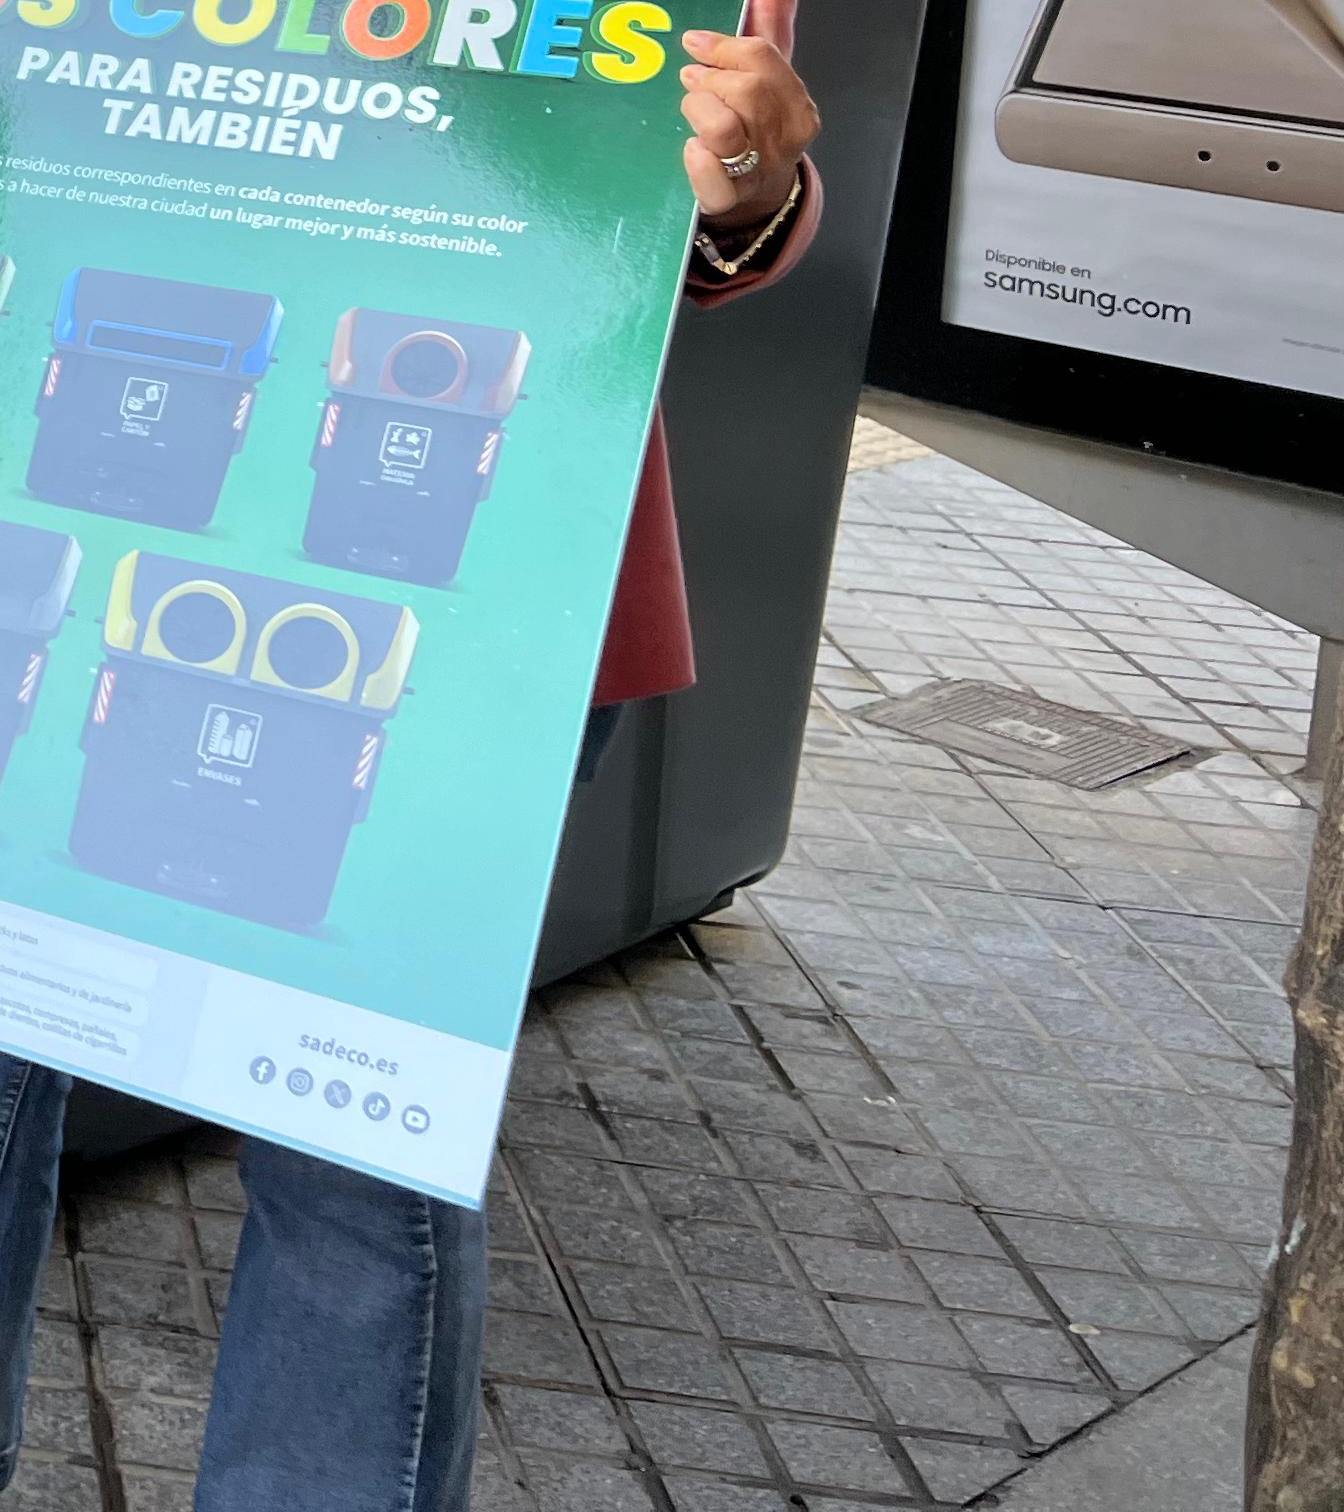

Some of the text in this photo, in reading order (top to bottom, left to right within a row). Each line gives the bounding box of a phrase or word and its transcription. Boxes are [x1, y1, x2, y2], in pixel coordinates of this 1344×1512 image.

[15, 46, 455, 132] PARA RESIDUOS,
[101, 97, 343, 162] TAMBIÉN
[5, 155, 71, 177] residuos
[73, 163, 212, 196] correspondientes
[214, 183, 236, 198] en
[238, 185, 280, 203] cada
[283, 190, 391, 217] contenedor
[391, 204, 449, 227] según
[452, 213, 475, 228] su
[477, 214, 529, 234] color
[7, 179, 18, 192] a
[19, 179, 63, 199] hacer
[65, 186, 87, 203] de
[88, 191, 149, 211] nuestra
[150, 198, 207, 219] ciudad
[210, 206, 233, 221] un
[235, 207, 283, 230] lugar
[284, 216, 342, 237] mejor
[340, 224, 355, 241] y
[357, 223, 397, 244] más
[397, 229, 503, 258] sostenible.
[984, 248, 1092, 280] Disponible en
[983, 270, 1192, 325] samsung.com
[298, 1032, 400, 1076] sadeco.es
